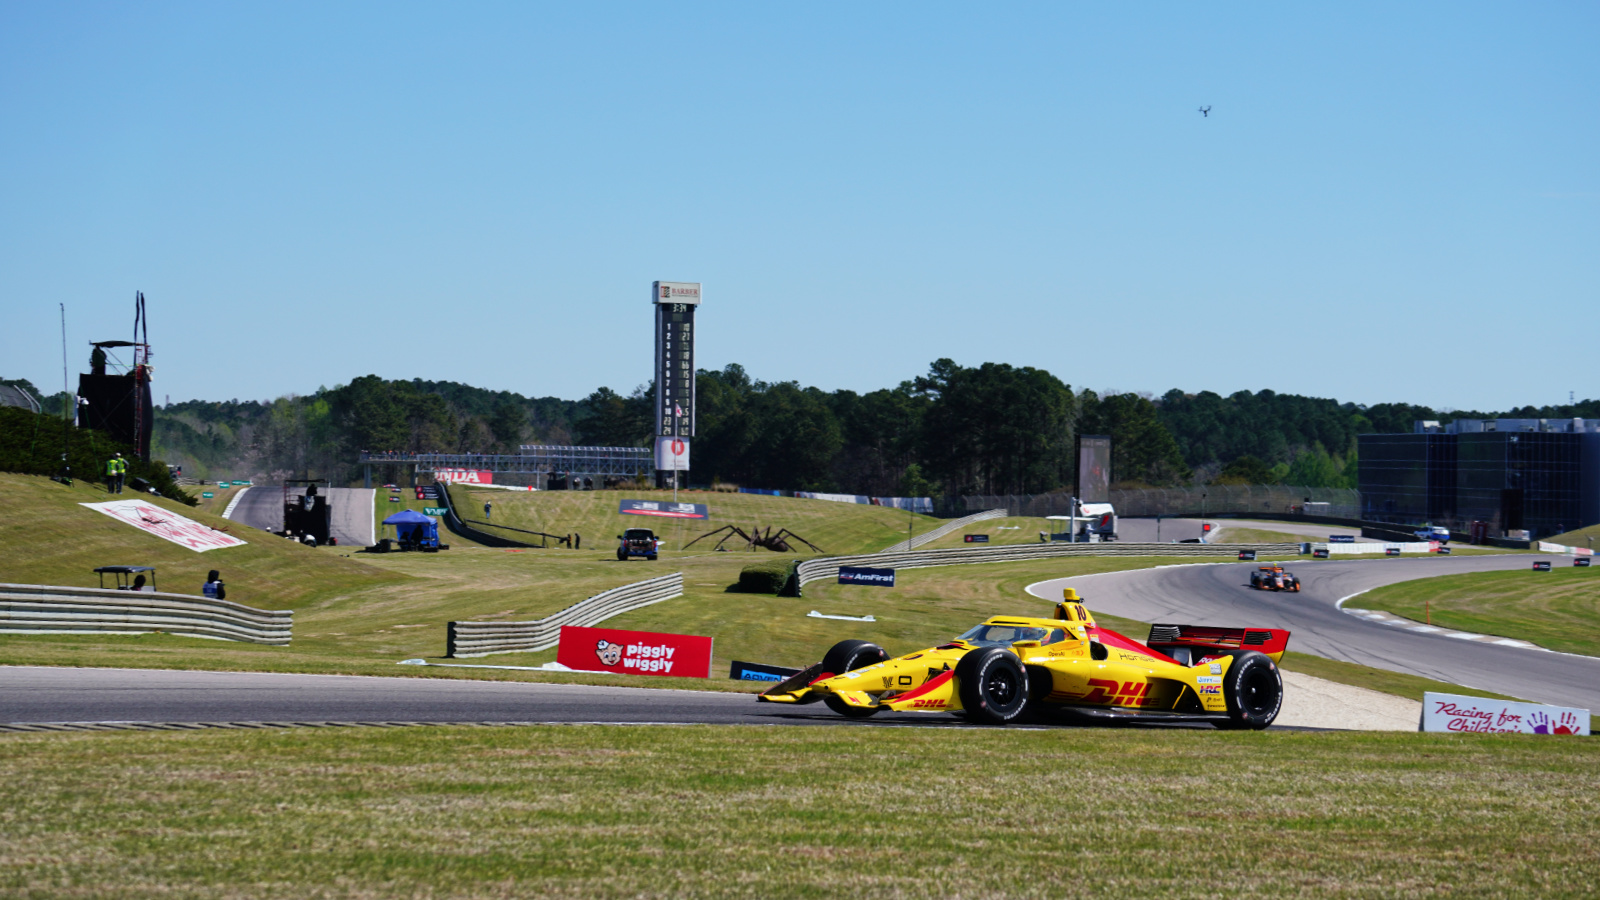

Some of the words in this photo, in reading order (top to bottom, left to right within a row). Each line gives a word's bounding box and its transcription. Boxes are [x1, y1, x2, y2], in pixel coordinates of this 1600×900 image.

[666, 332, 672, 340] 2
[665, 341, 671, 350] 3
[665, 360, 671, 368] 5
[665, 379, 671, 387] 7
[854, 573, 894, 582] AmFirst
[1074, 604, 1087, 621] 10
[626, 642, 675, 658] piggly
[623, 656, 674, 673] wiggly
[1084, 678, 1154, 706] DHL
[1199, 685, 1221, 693] HRC
[913, 699, 947, 708] DHL
[1435, 701, 1494, 724] Racing
[1496, 708, 1522, 726] for
